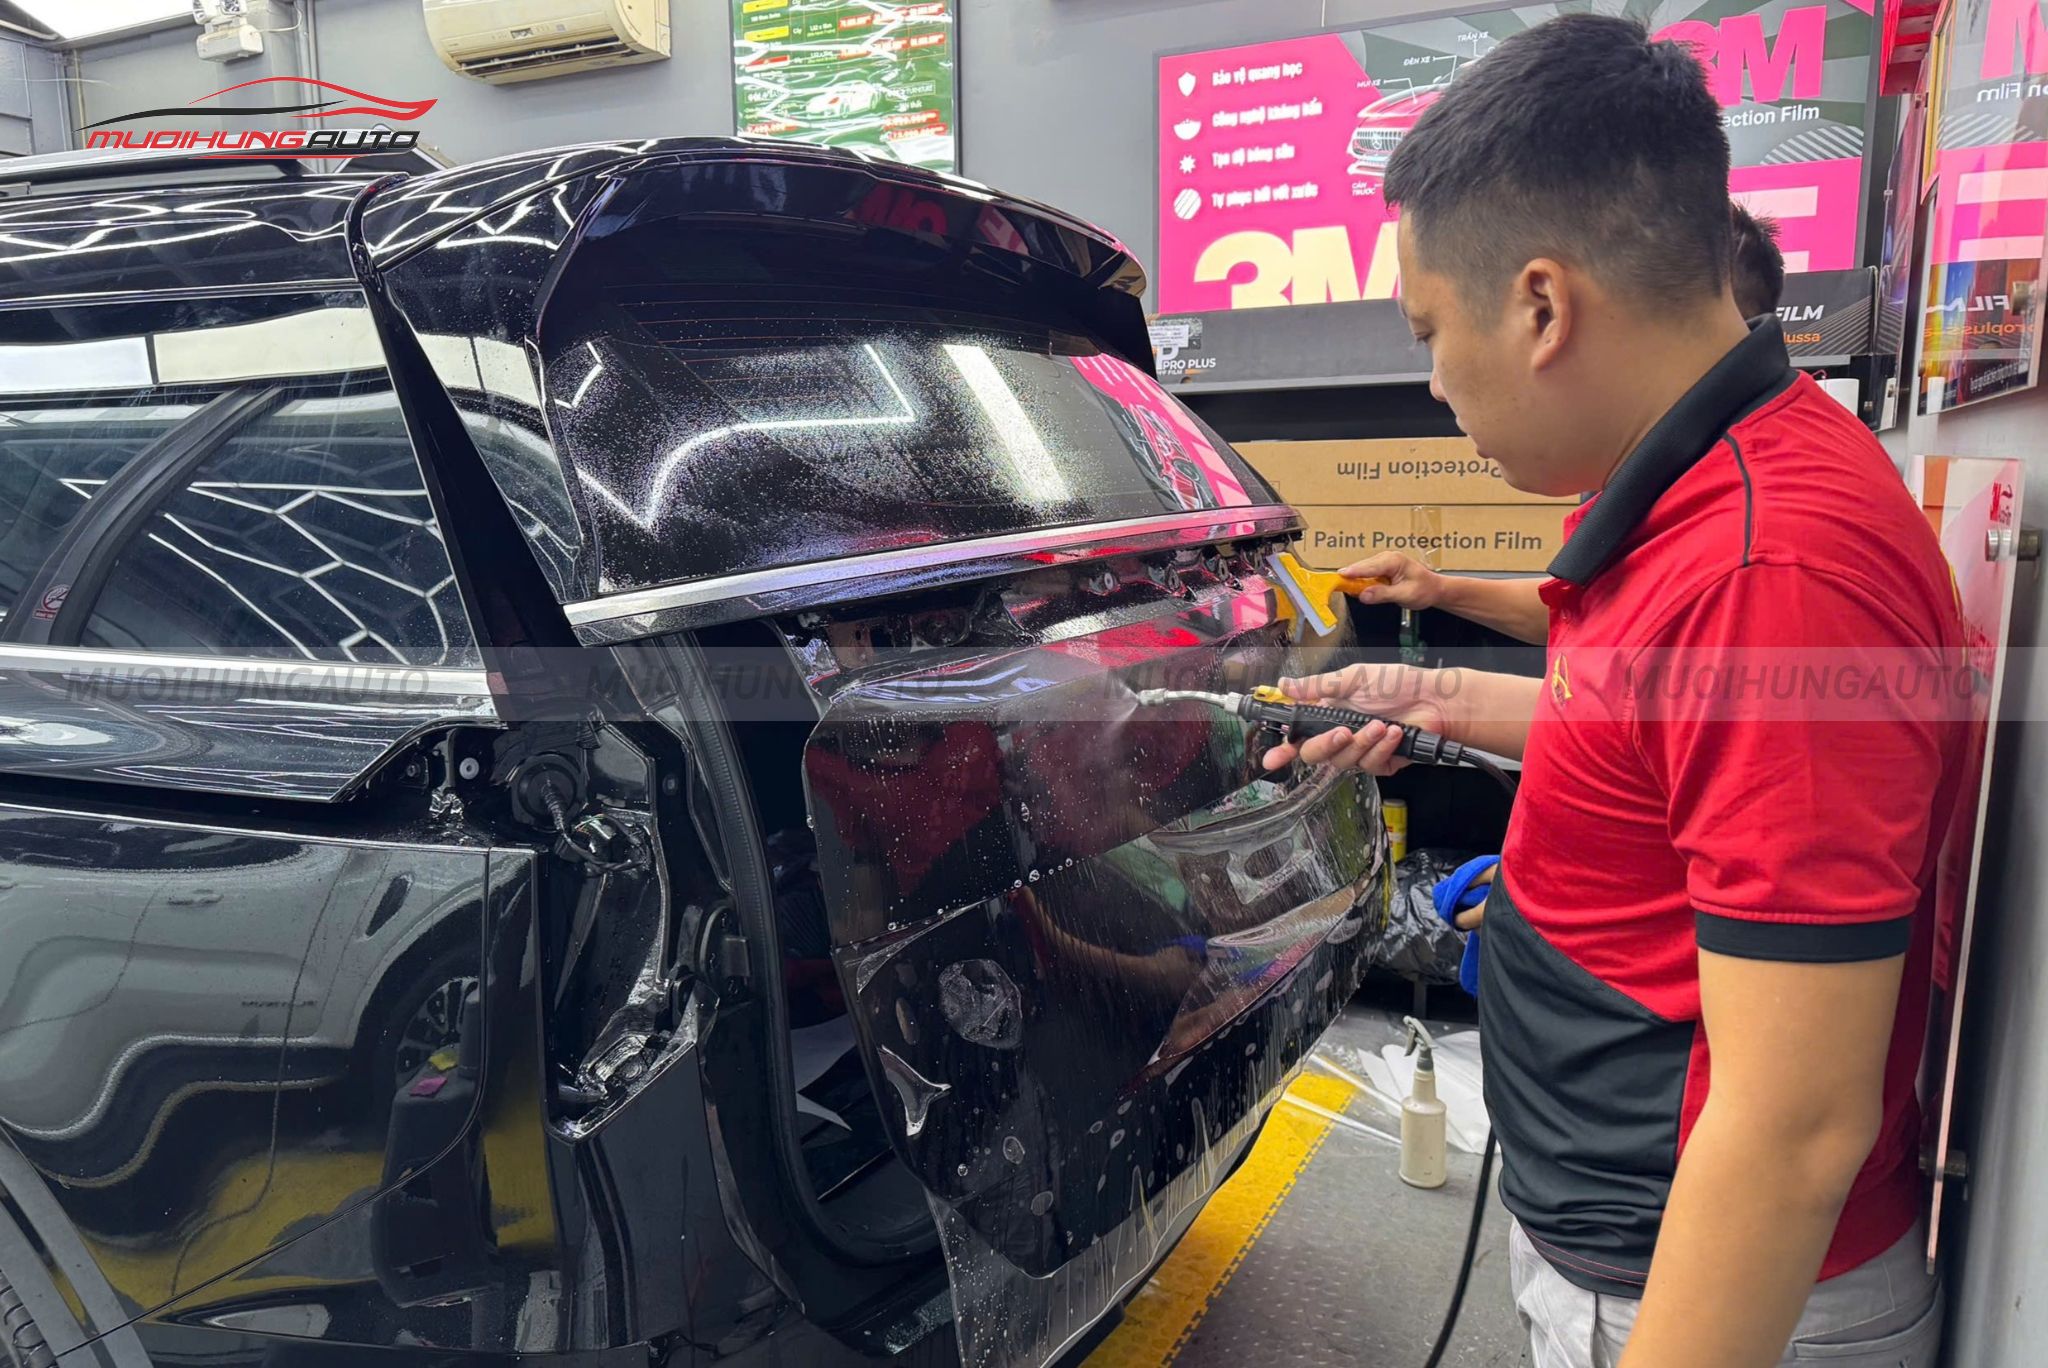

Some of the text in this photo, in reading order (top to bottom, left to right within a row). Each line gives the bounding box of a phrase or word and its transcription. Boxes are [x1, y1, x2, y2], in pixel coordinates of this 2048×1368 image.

[1721, 104, 1820, 128] ection Film
[1776, 305, 1825, 322] FILM
[1163, 358, 1217, 370] PRO PLUS
[1337, 461, 1381, 480] Film
[1315, 531, 1542, 550] Paint Protection Film
